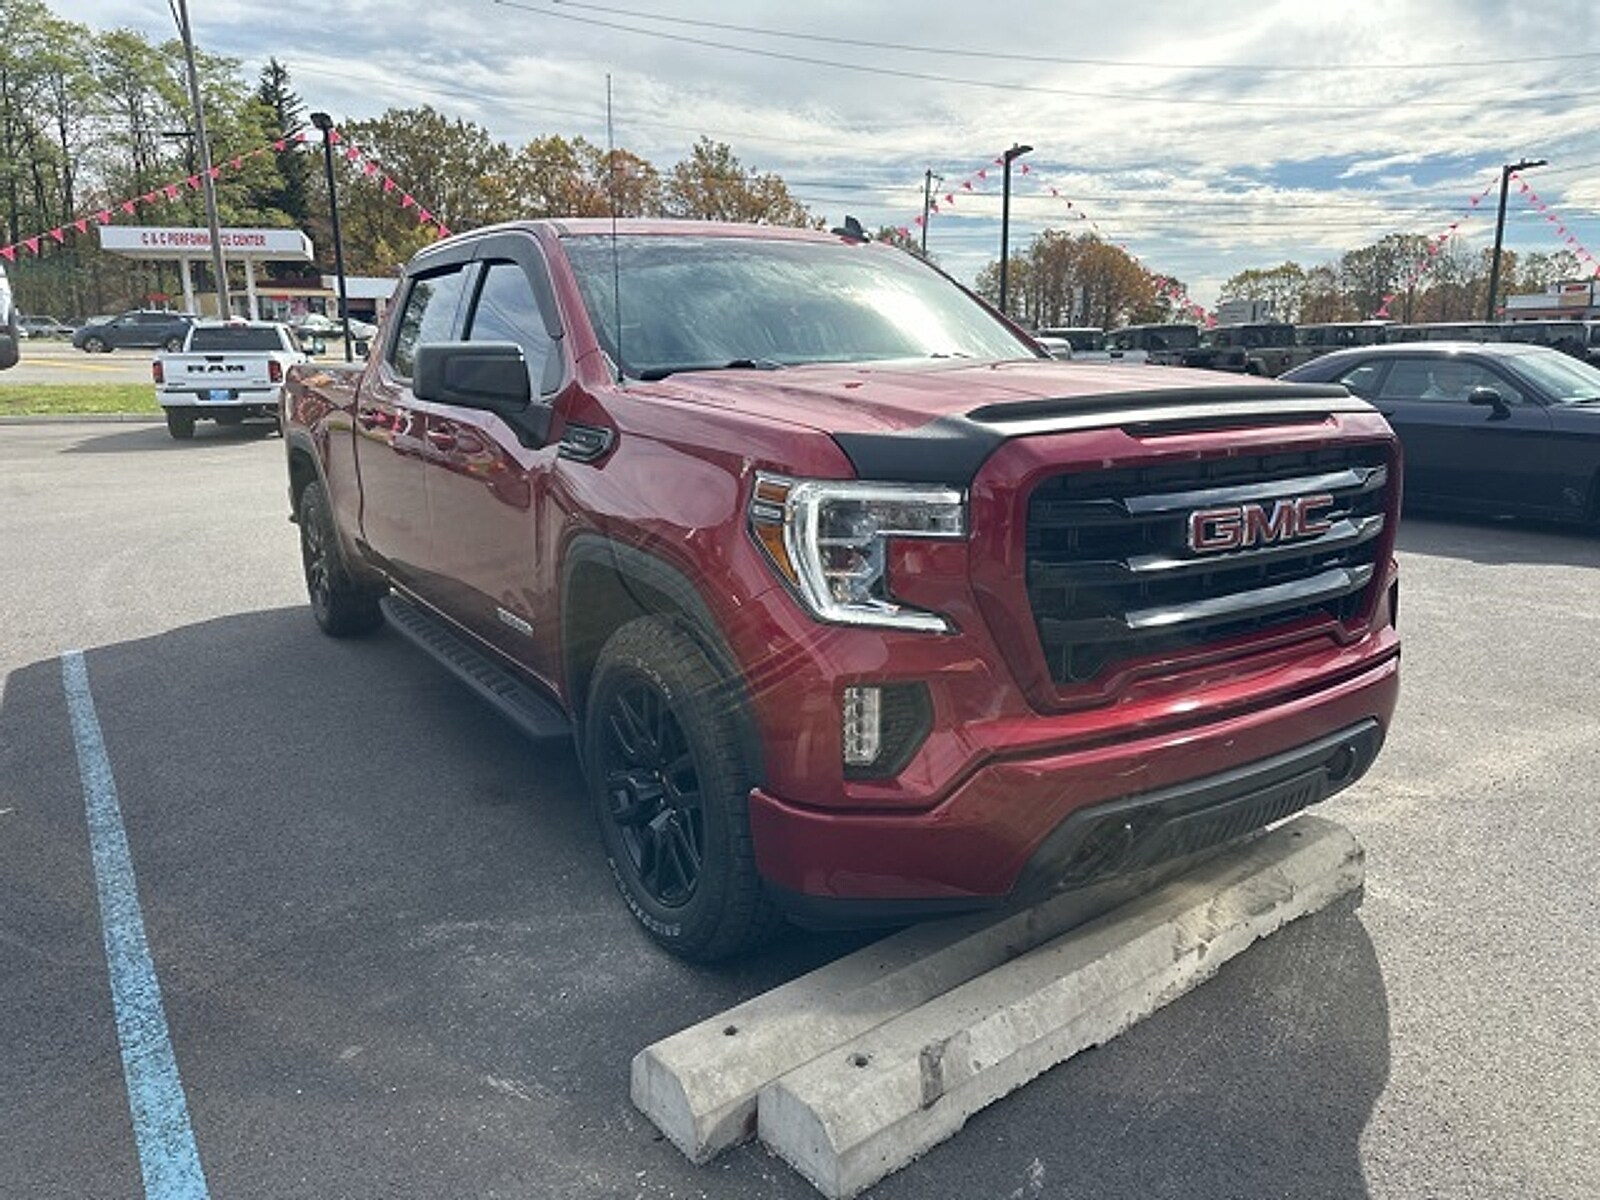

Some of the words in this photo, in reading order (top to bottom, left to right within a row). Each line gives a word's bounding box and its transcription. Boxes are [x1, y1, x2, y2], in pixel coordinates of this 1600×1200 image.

[168, 233, 231, 246] PERFORMCE
[233, 234, 266, 246] CENTER
[1188, 494, 1334, 552] GMC
